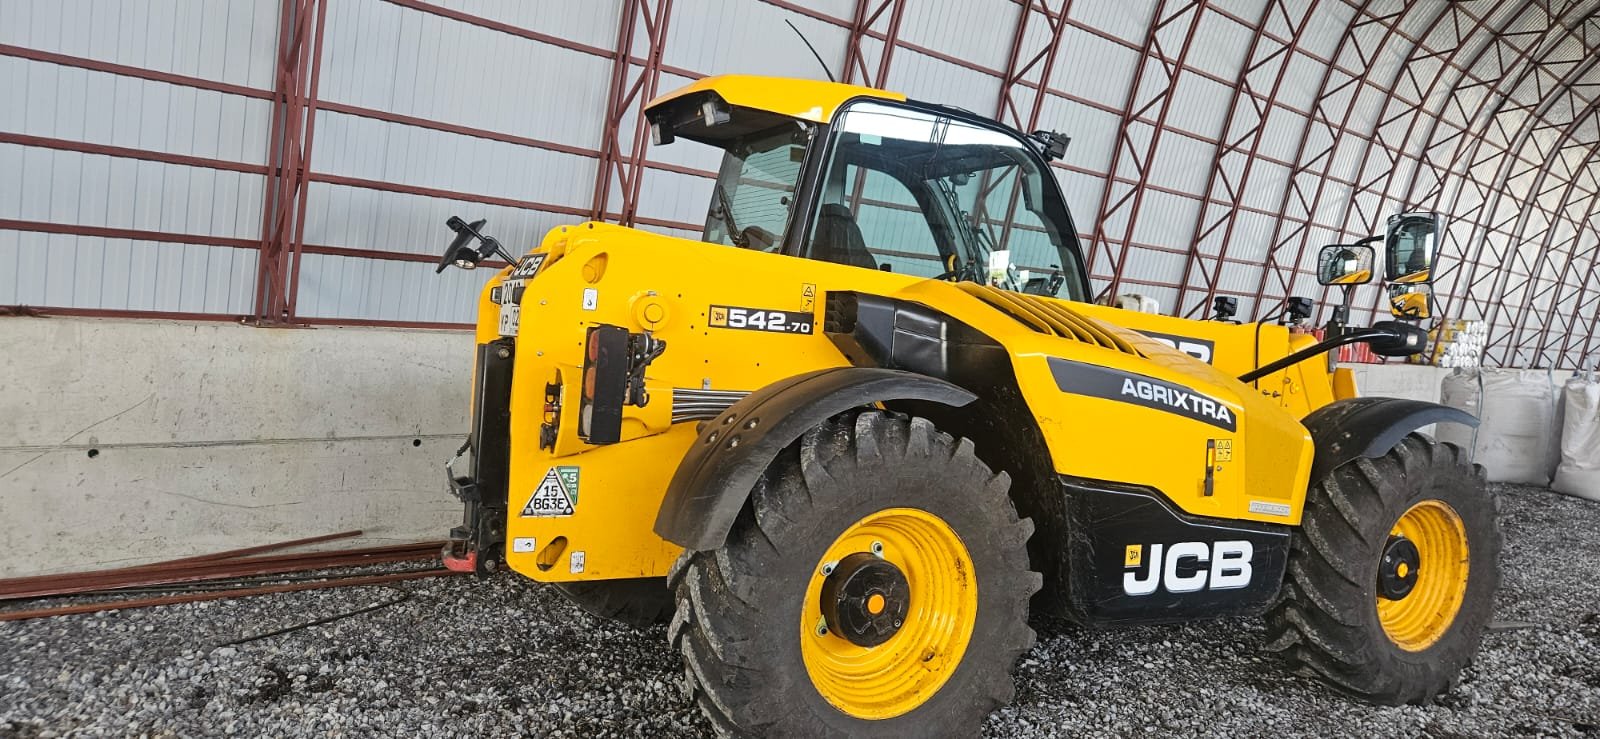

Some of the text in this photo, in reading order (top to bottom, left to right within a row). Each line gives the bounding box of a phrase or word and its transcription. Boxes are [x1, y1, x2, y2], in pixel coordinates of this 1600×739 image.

[513, 256, 544, 276] JCB
[728, 308, 811, 334] 542-70
[1121, 378, 1232, 424] AGRIXTRA
[543, 485, 559, 497] 15
[1123, 540, 1254, 596] JCB
